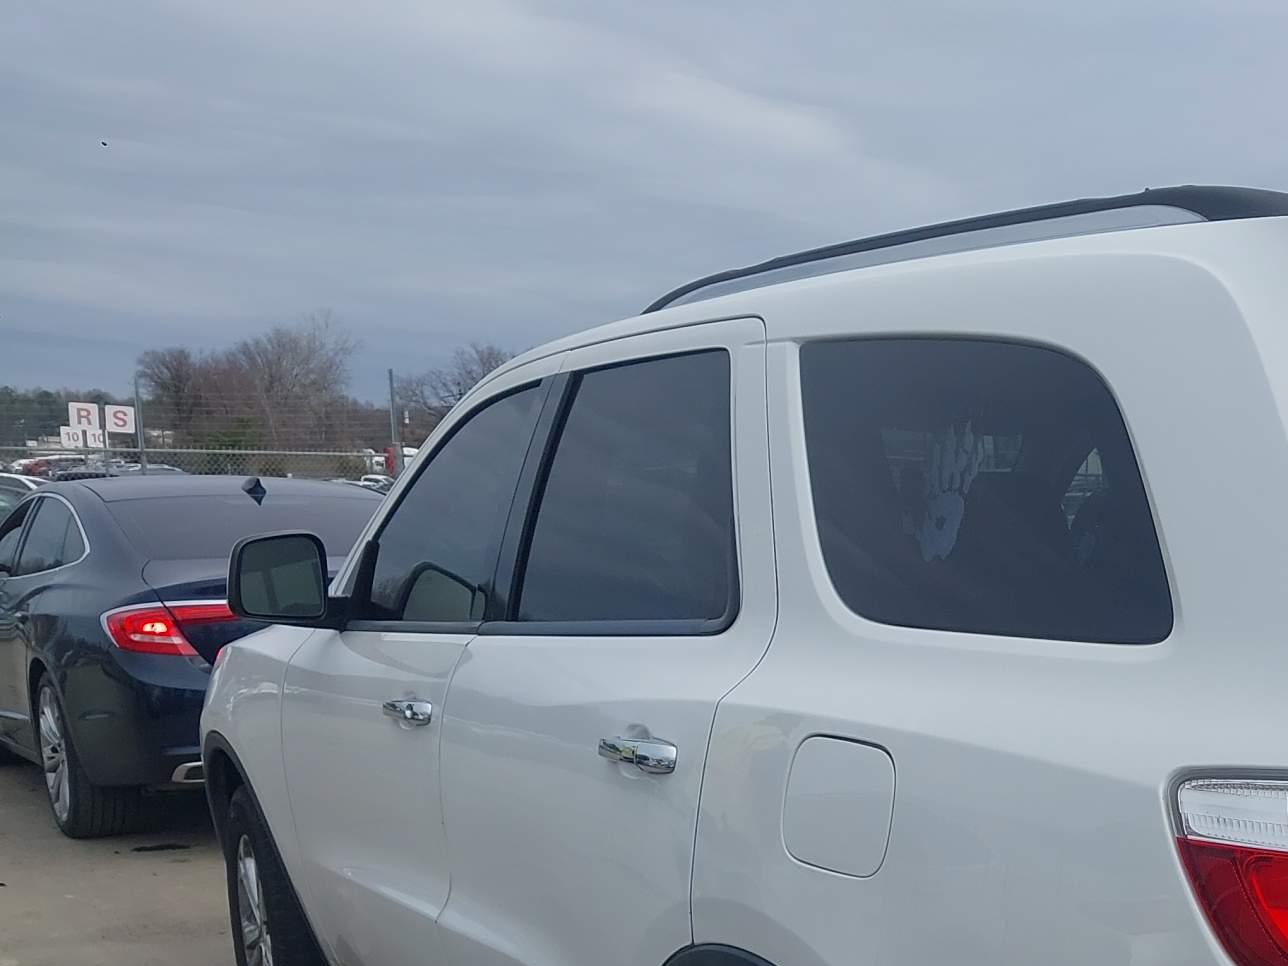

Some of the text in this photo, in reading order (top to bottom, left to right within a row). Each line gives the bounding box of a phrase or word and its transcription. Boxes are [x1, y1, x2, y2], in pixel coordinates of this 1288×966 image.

[76, 408, 92, 426] R
[112, 410, 128, 428] S
[65, 432, 79, 442] 10
